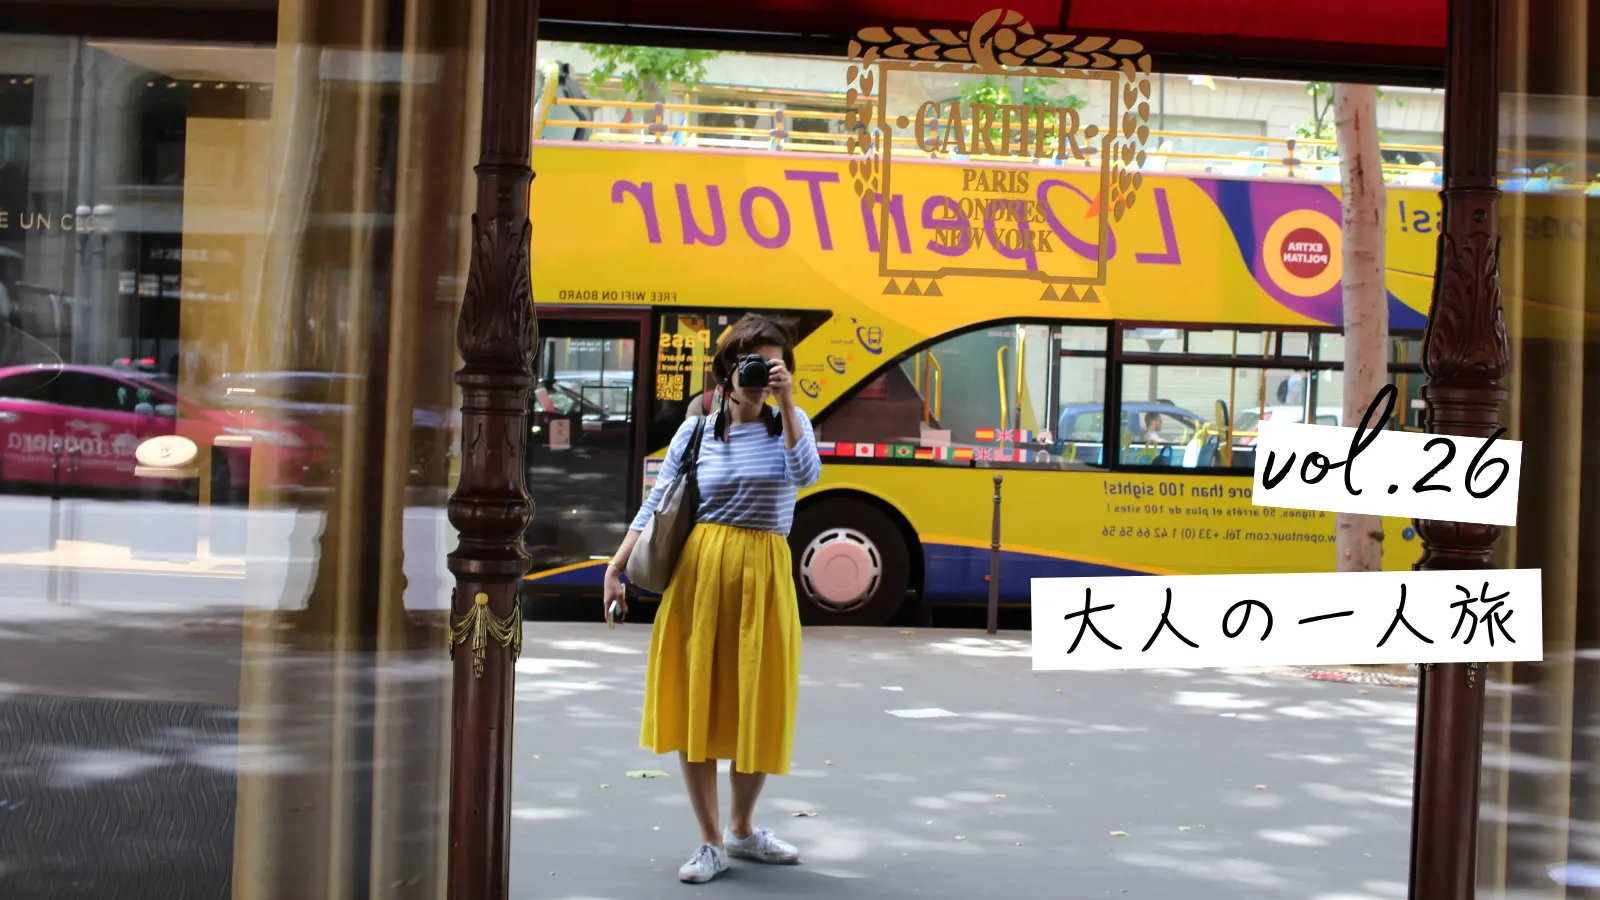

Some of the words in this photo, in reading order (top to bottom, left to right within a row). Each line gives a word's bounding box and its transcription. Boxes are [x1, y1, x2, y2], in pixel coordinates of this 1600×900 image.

[915, 101, 1084, 160] CARTIER
[962, 169, 1029, 194] PARIS
[20, 212, 51, 230] UN
[942, 197, 1048, 224] LONDRES
[934, 226, 984, 250] NEW
[993, 228, 1053, 253] YORK
